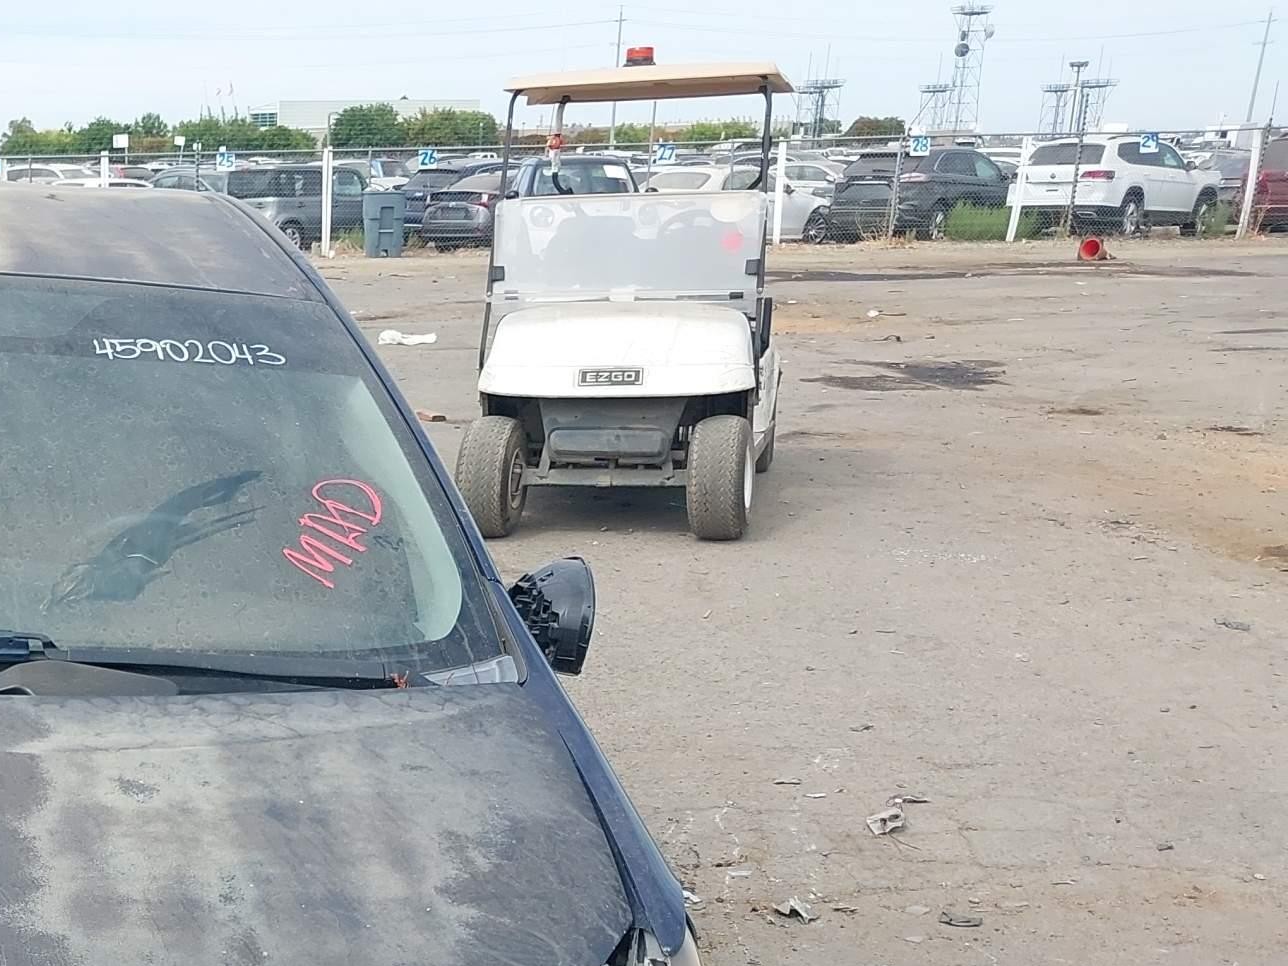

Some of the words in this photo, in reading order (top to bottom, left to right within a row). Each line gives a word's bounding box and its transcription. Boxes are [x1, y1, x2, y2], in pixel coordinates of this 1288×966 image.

[912, 136, 929, 153] 28
[1142, 132, 1159, 149] 29
[419, 148, 436, 165] 26
[658, 143, 675, 160] 27
[218, 153, 233, 168] 25
[93, 337, 287, 367] 45902043
